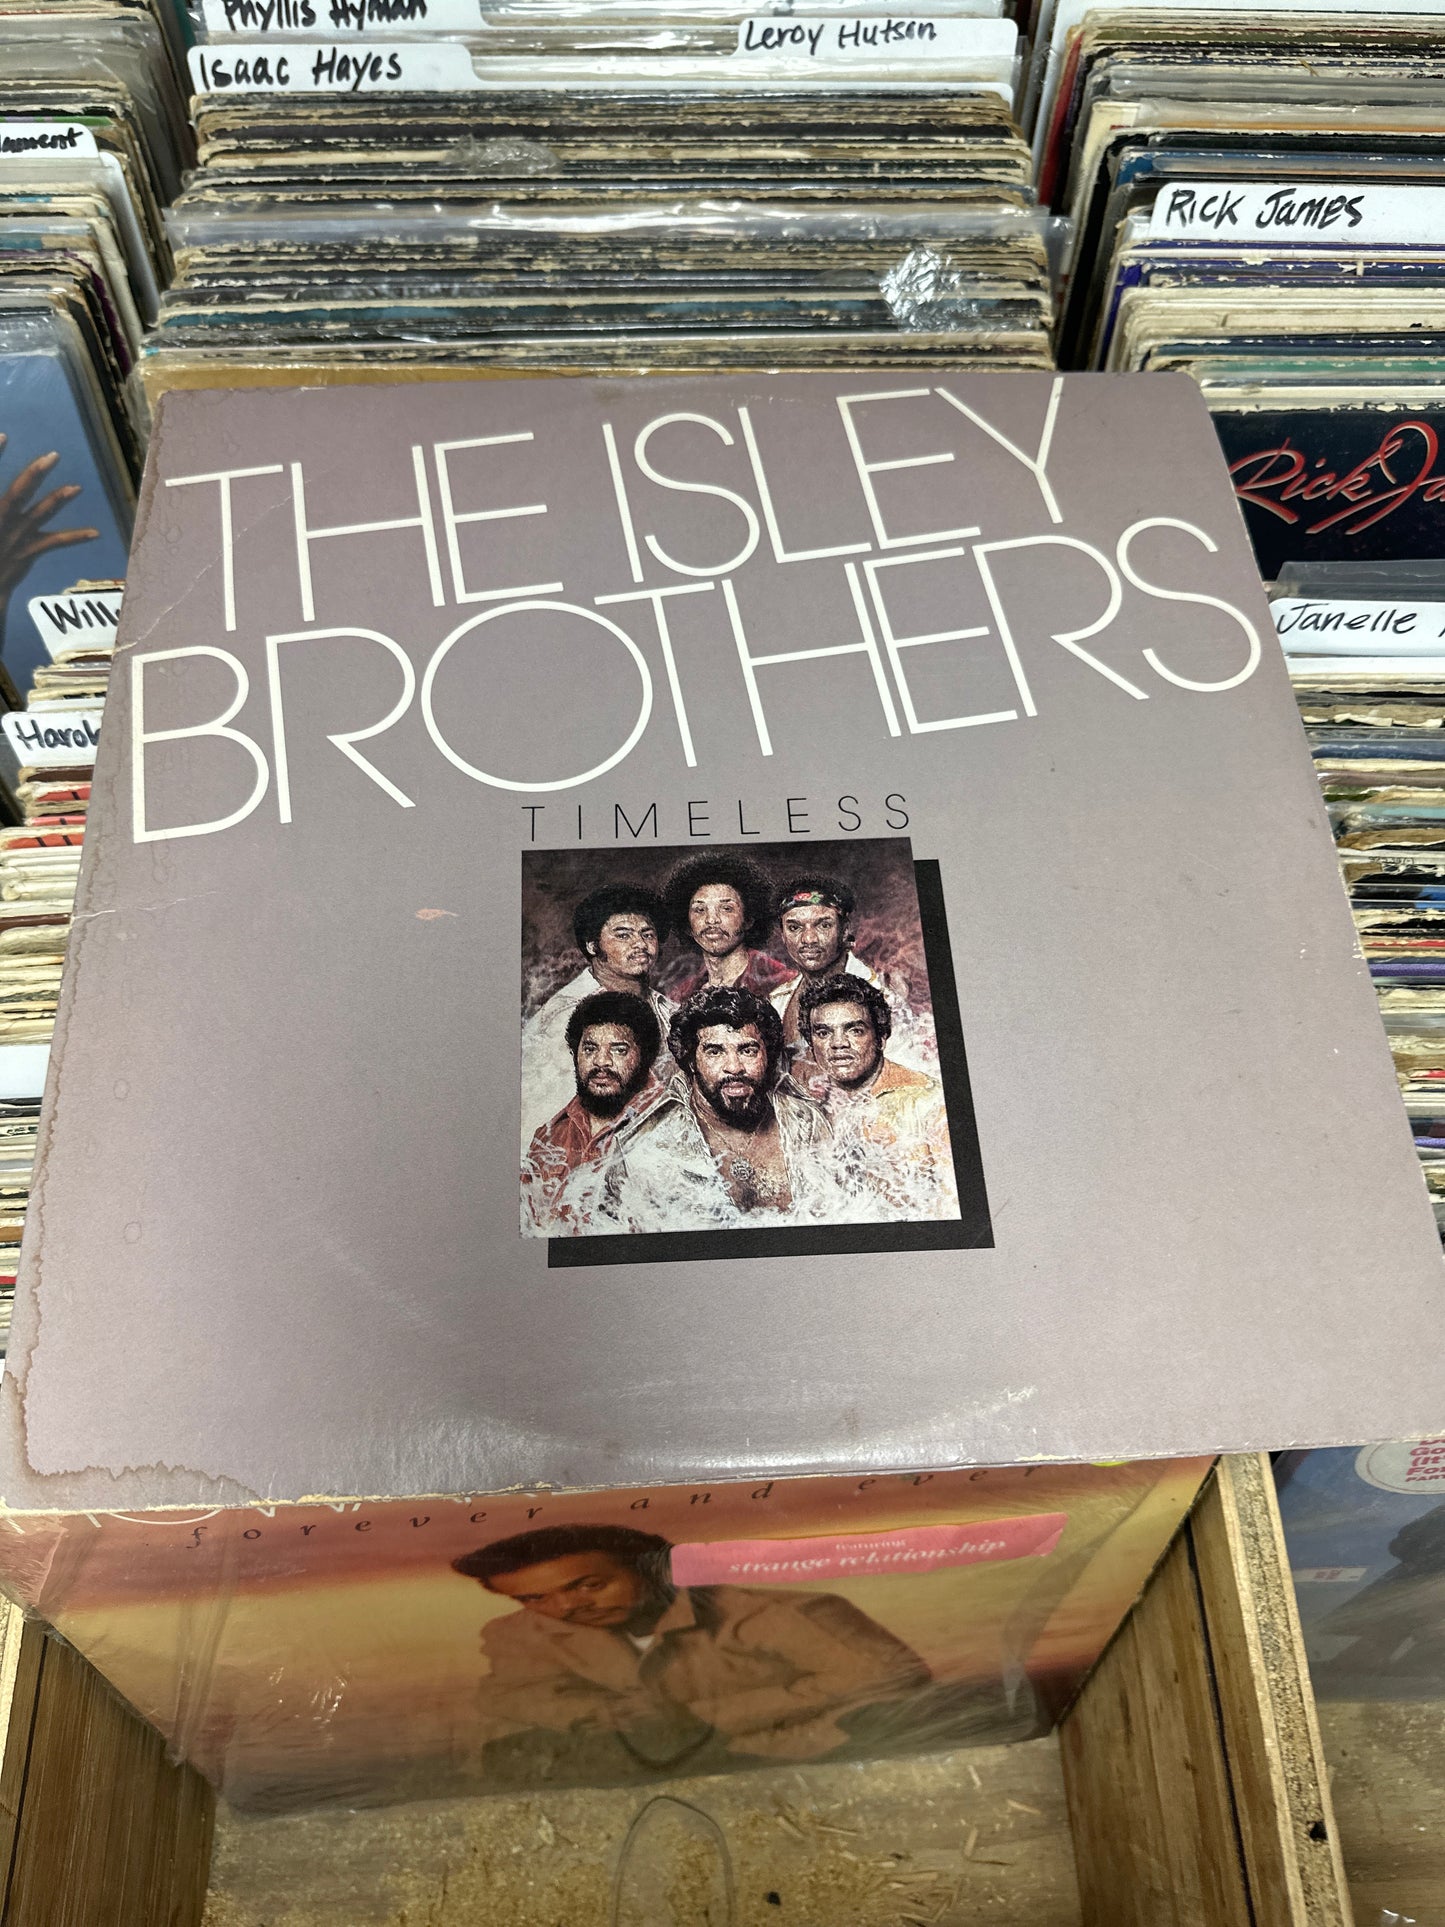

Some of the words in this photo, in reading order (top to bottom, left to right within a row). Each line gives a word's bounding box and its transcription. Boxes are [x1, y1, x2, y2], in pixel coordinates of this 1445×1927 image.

[744, 20, 825, 56] Leroy
[837, 19, 937, 50] Hutson
[200, 53, 290, 91] Isaac
[312, 46, 402, 92] Hayes
[1166, 189, 1246, 229] Rick
[1255, 187, 1365, 230] James
[165, 432, 564, 632] THE
[602, 376, 1063, 583] ISLEY
[1229, 437, 1404, 525] Rick
[1275, 602, 1418, 635] Janelle
[132, 516, 1262, 844] BROTHERS
[521, 793, 910, 842] TIMELESS
[186, 1506, 544, 1549] forever
[630, 1482, 774, 1510] and
[858, 1465, 1043, 1491] ever
